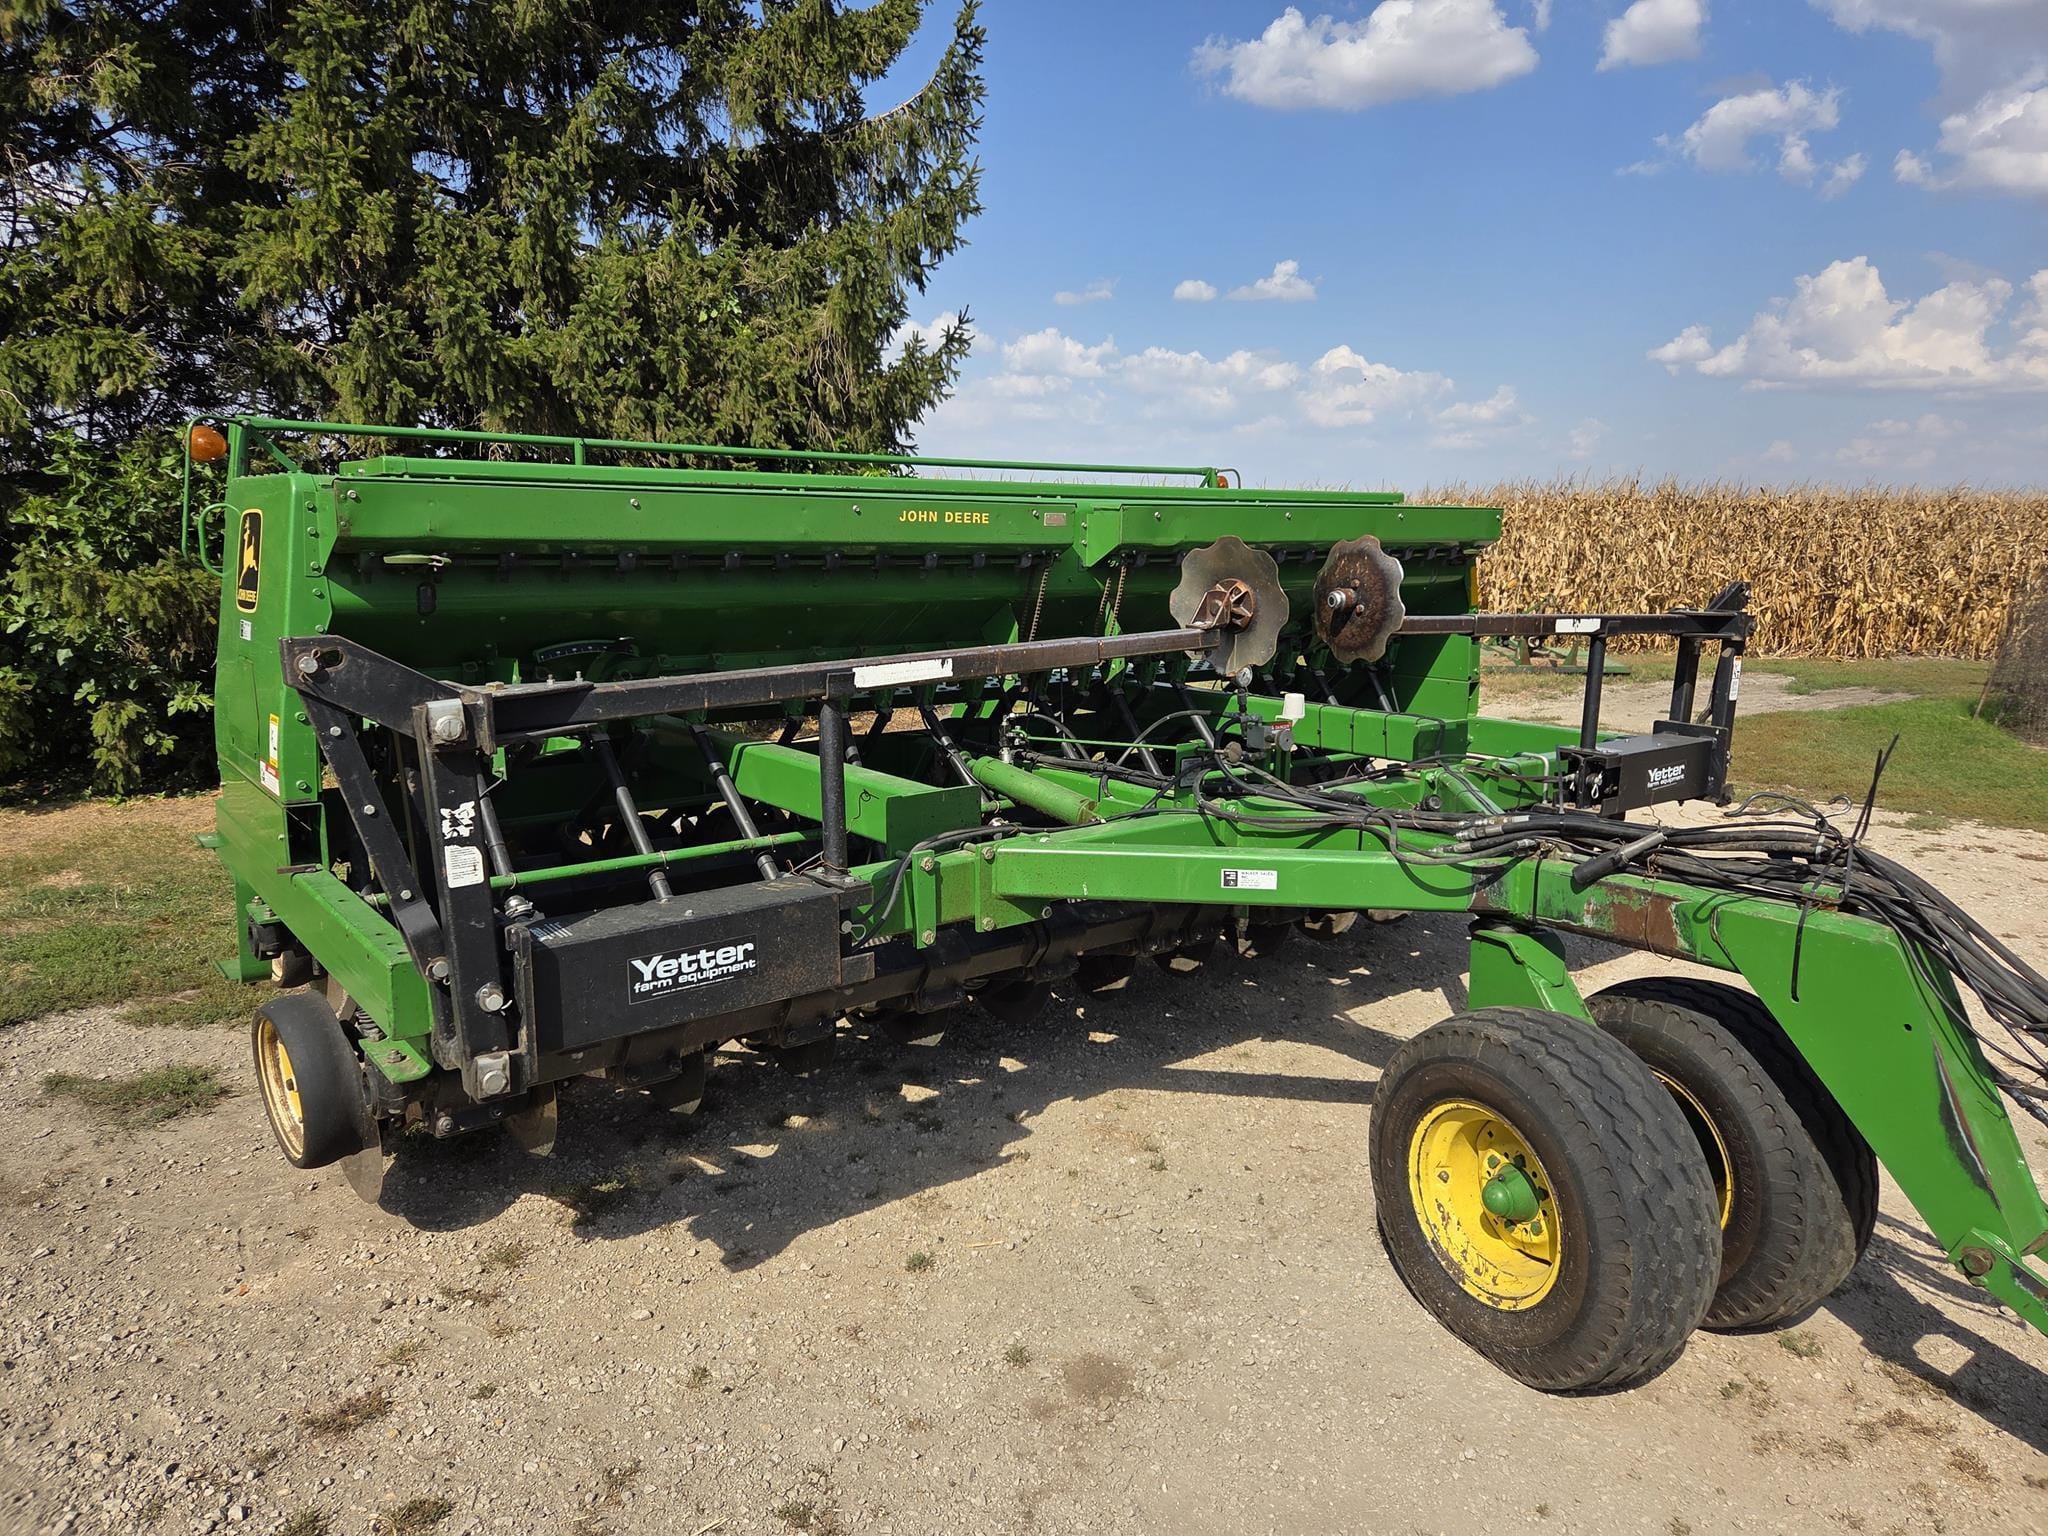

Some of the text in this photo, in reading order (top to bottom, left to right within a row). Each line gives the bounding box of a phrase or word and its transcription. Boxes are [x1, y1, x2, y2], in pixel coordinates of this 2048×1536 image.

[899, 510, 990, 524] JOHN DEERE
[1647, 764, 1686, 782] Yetter
[630, 942, 755, 982] Yetter
[633, 977, 673, 994] farm
[678, 959, 757, 984] equipment
